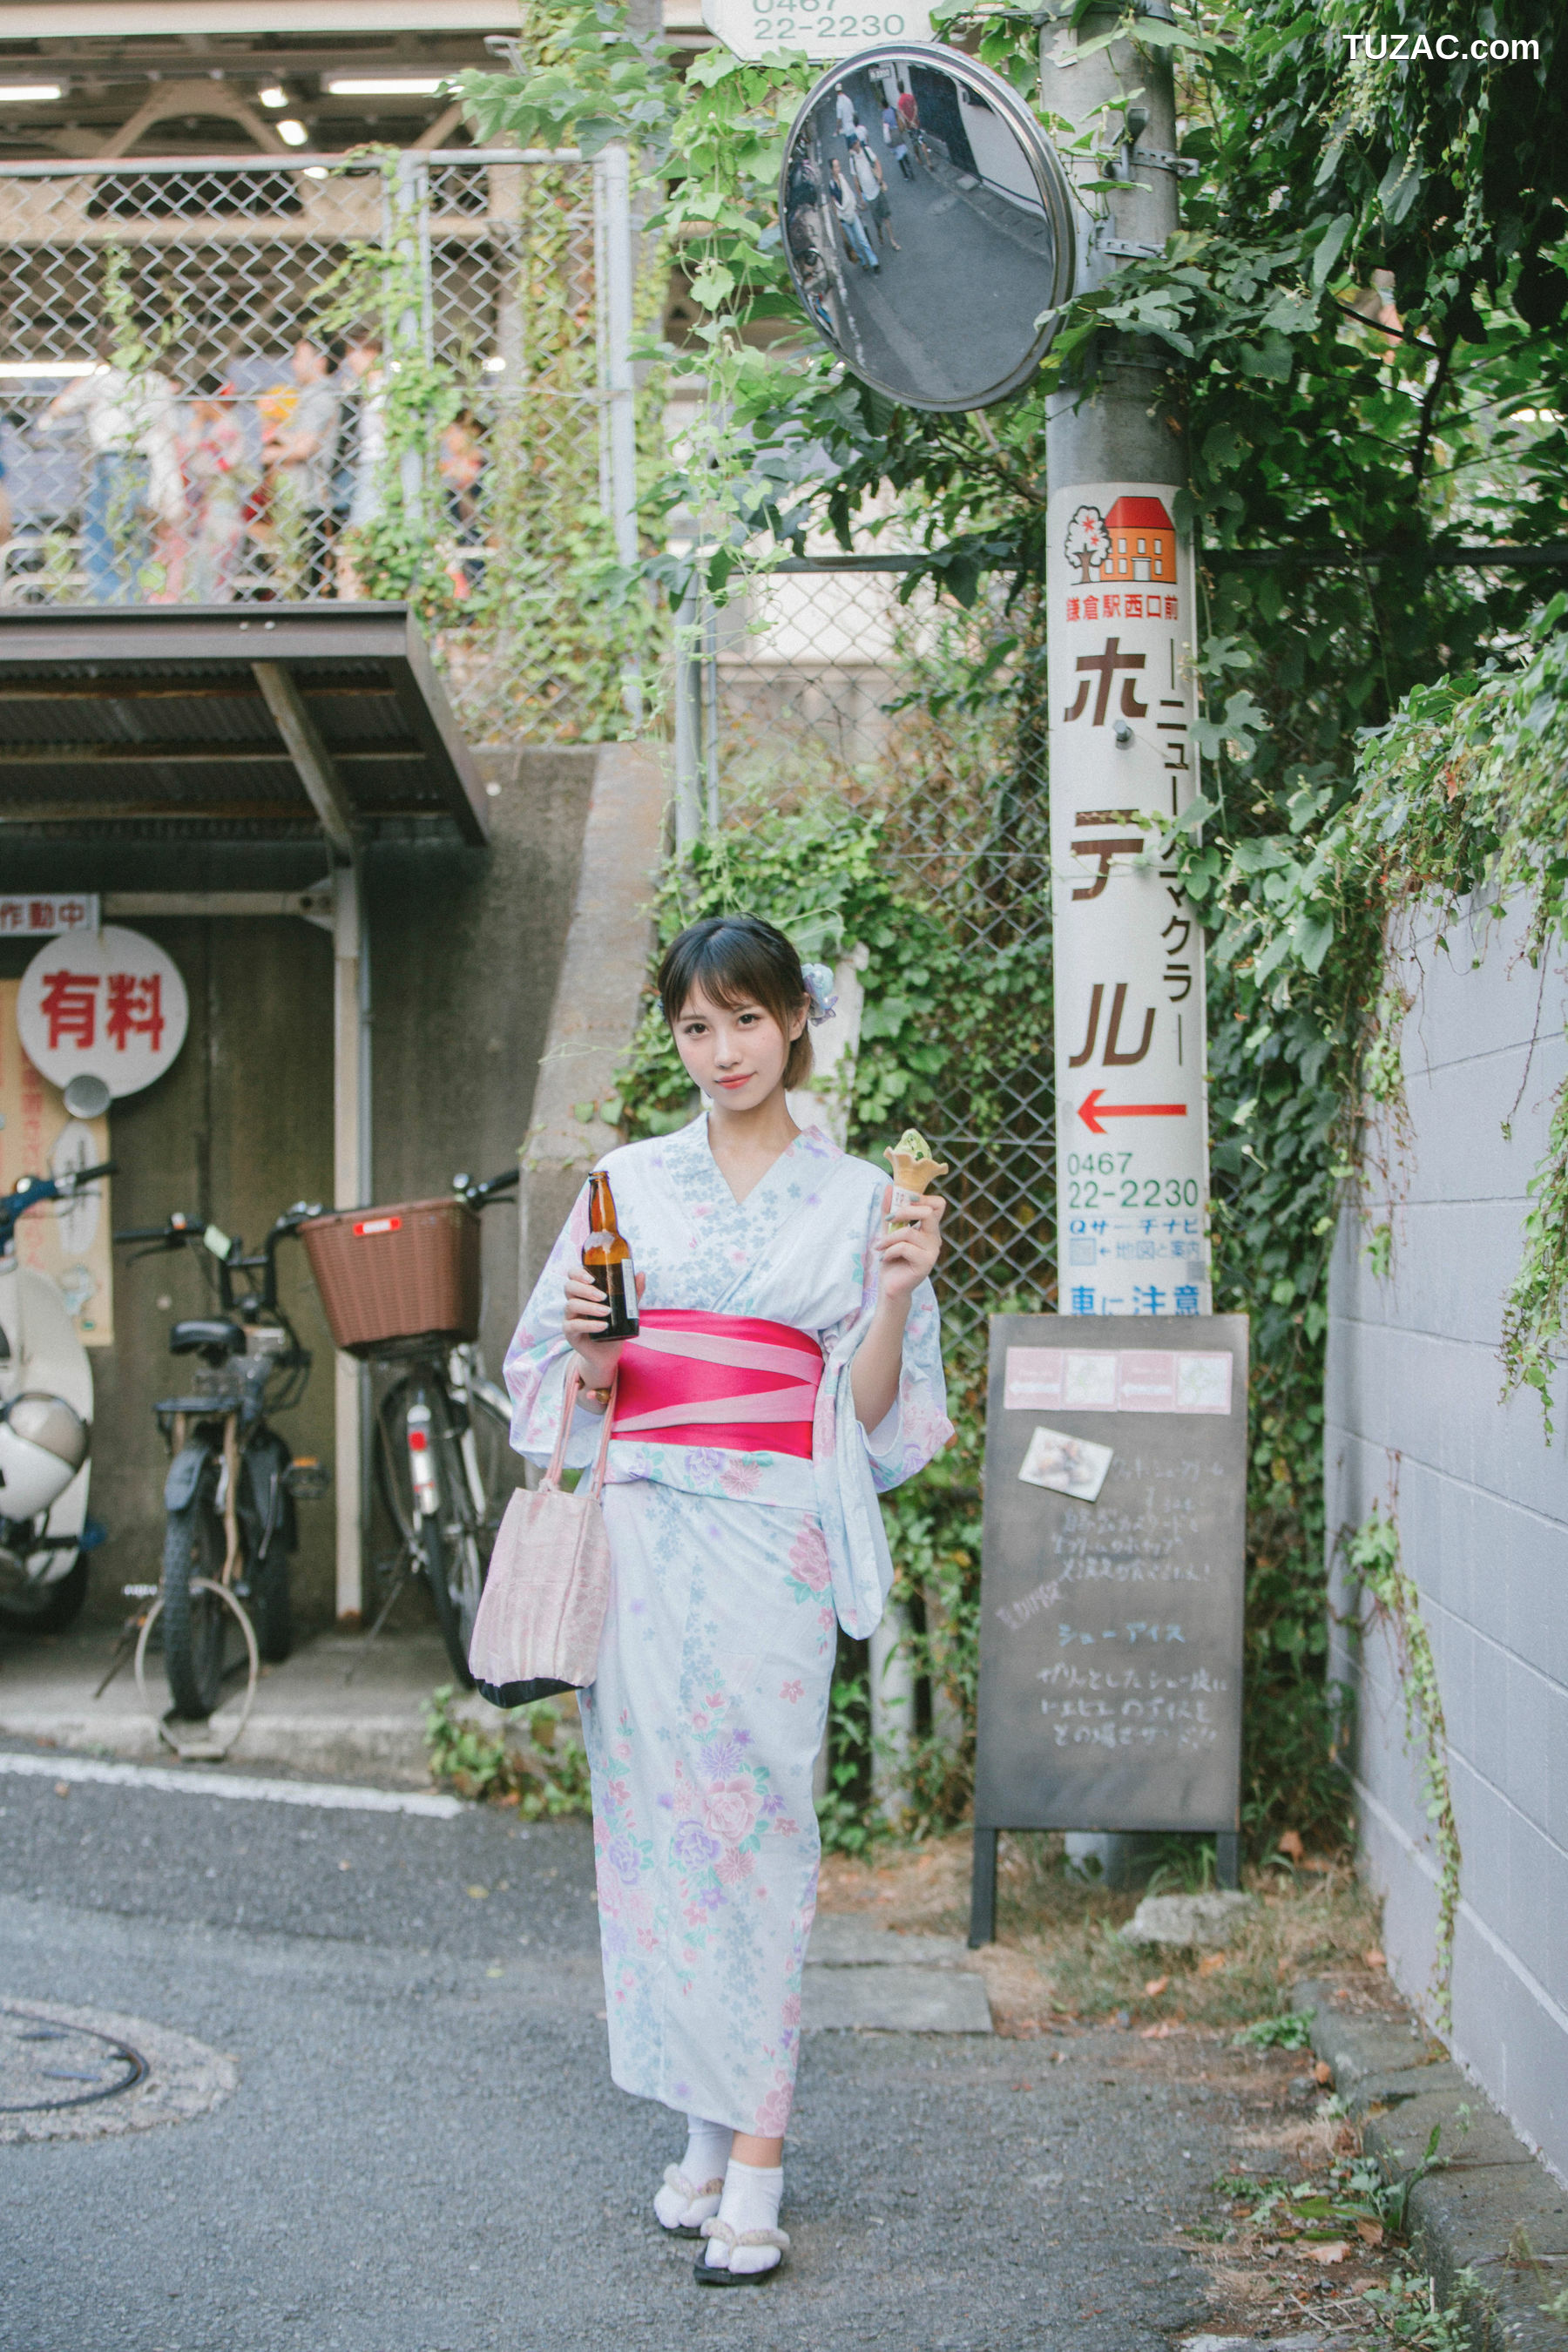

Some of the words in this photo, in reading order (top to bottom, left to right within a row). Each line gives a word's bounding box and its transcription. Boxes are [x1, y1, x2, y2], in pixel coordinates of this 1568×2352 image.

[754, 14, 905, 40] 22-2230
[1063, 637, 1156, 1069] ホテル
[40, 969, 165, 1051] 有料
[1067, 1152, 1133, 1176] 0467
[1068, 1179, 1200, 1209] 22-2230
[1071, 1285, 1200, 1316] 車に注意
